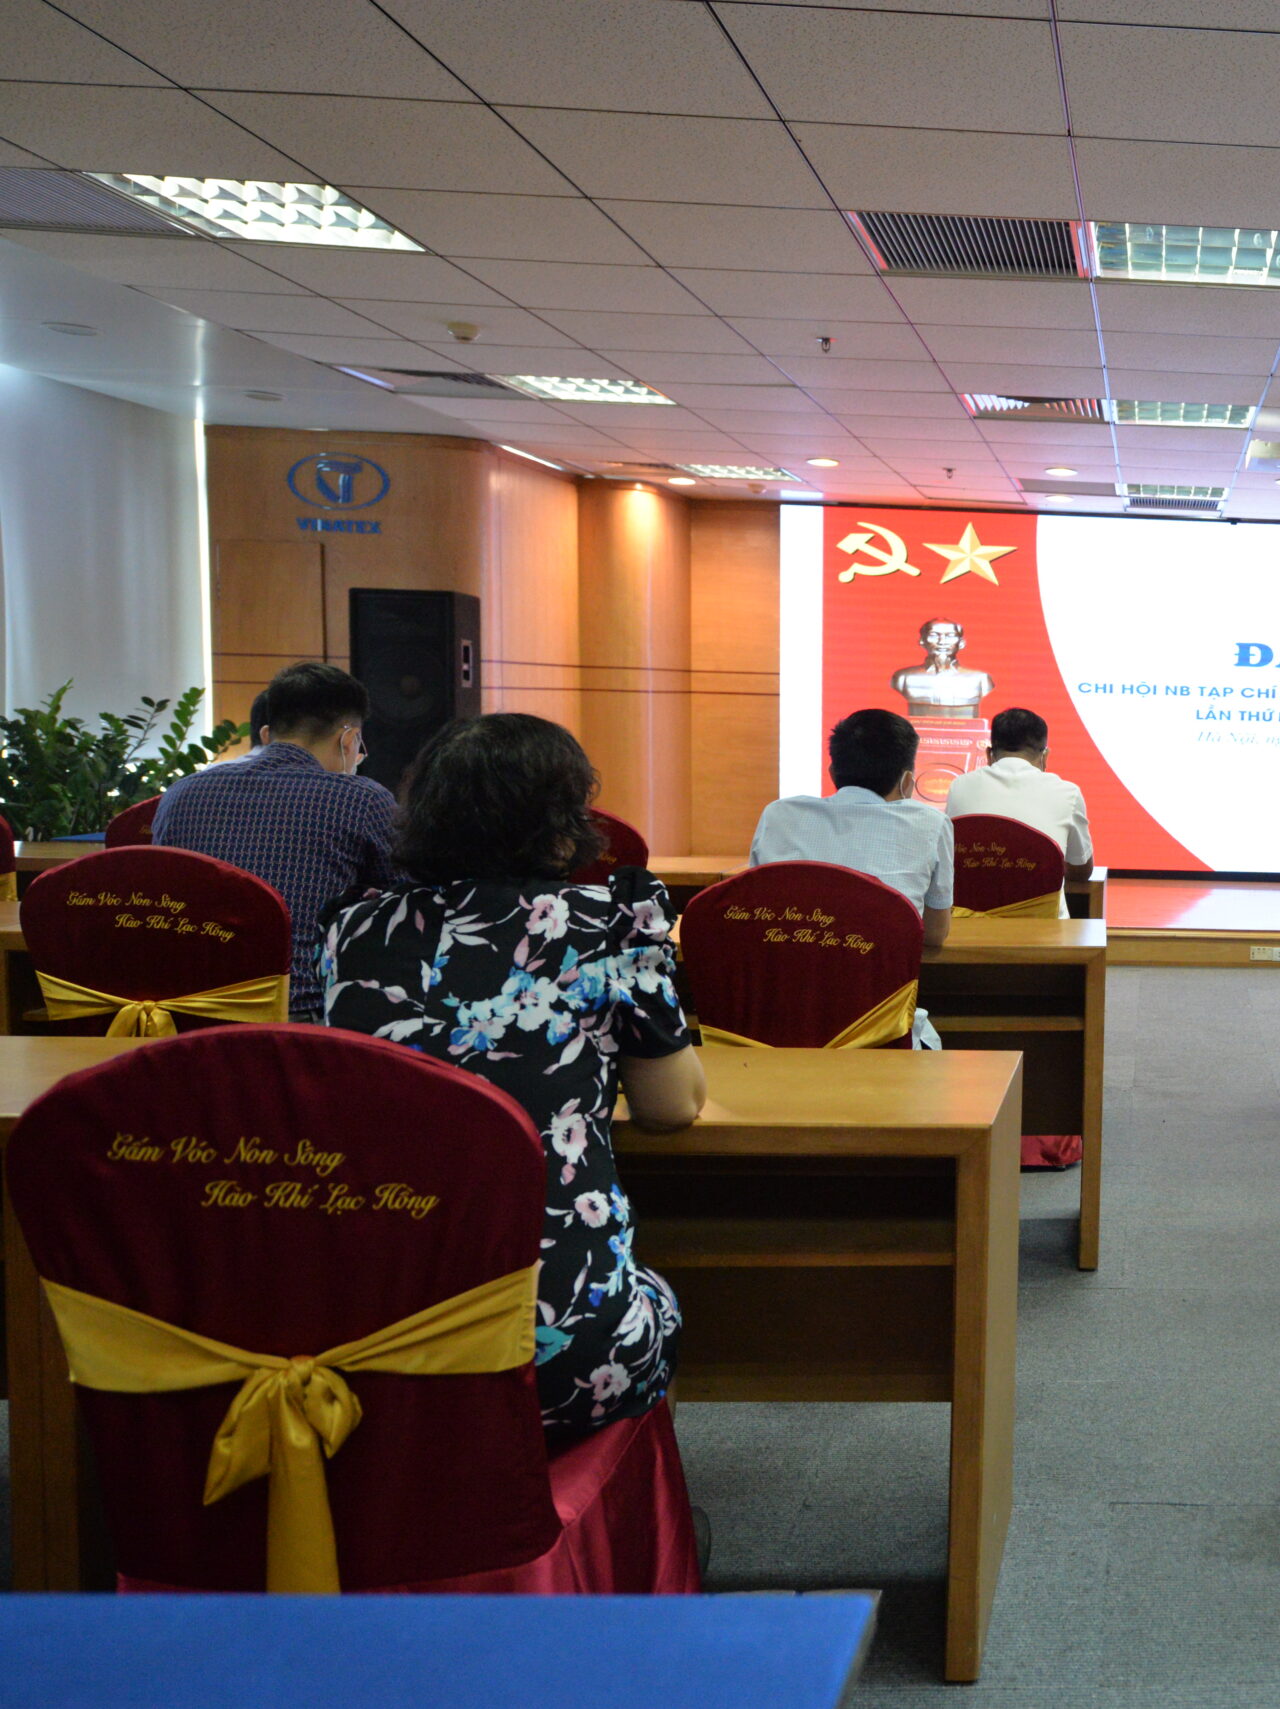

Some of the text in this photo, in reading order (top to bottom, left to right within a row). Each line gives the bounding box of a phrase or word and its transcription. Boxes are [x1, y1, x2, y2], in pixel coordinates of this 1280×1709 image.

[296, 517, 382, 534] VINATEX
[1078, 682, 1113, 694] CHI
[1121, 681, 1157, 698] HỘI
[1165, 685, 1191, 696] NB
[1198, 686, 1234, 701] TẠP
[1240, 685, 1277, 699] CHÍ
[1196, 704, 1232, 721] LẦN
[1239, 708, 1275, 723] THỨ
[1197, 731, 1221, 743] Hà
[753, 906, 776, 921] Vóc
[778, 906, 804, 921] Non
[763, 928, 790, 943] Hào
[792, 928, 820, 943] Khí
[818, 930, 841, 948] Lạc
[169, 1136, 218, 1164] Vóc
[224, 1136, 279, 1165] Non
[200, 1180, 259, 1208] Hào
[263, 1180, 320, 1209] Khí
[319, 1183, 366, 1216] Lạc
